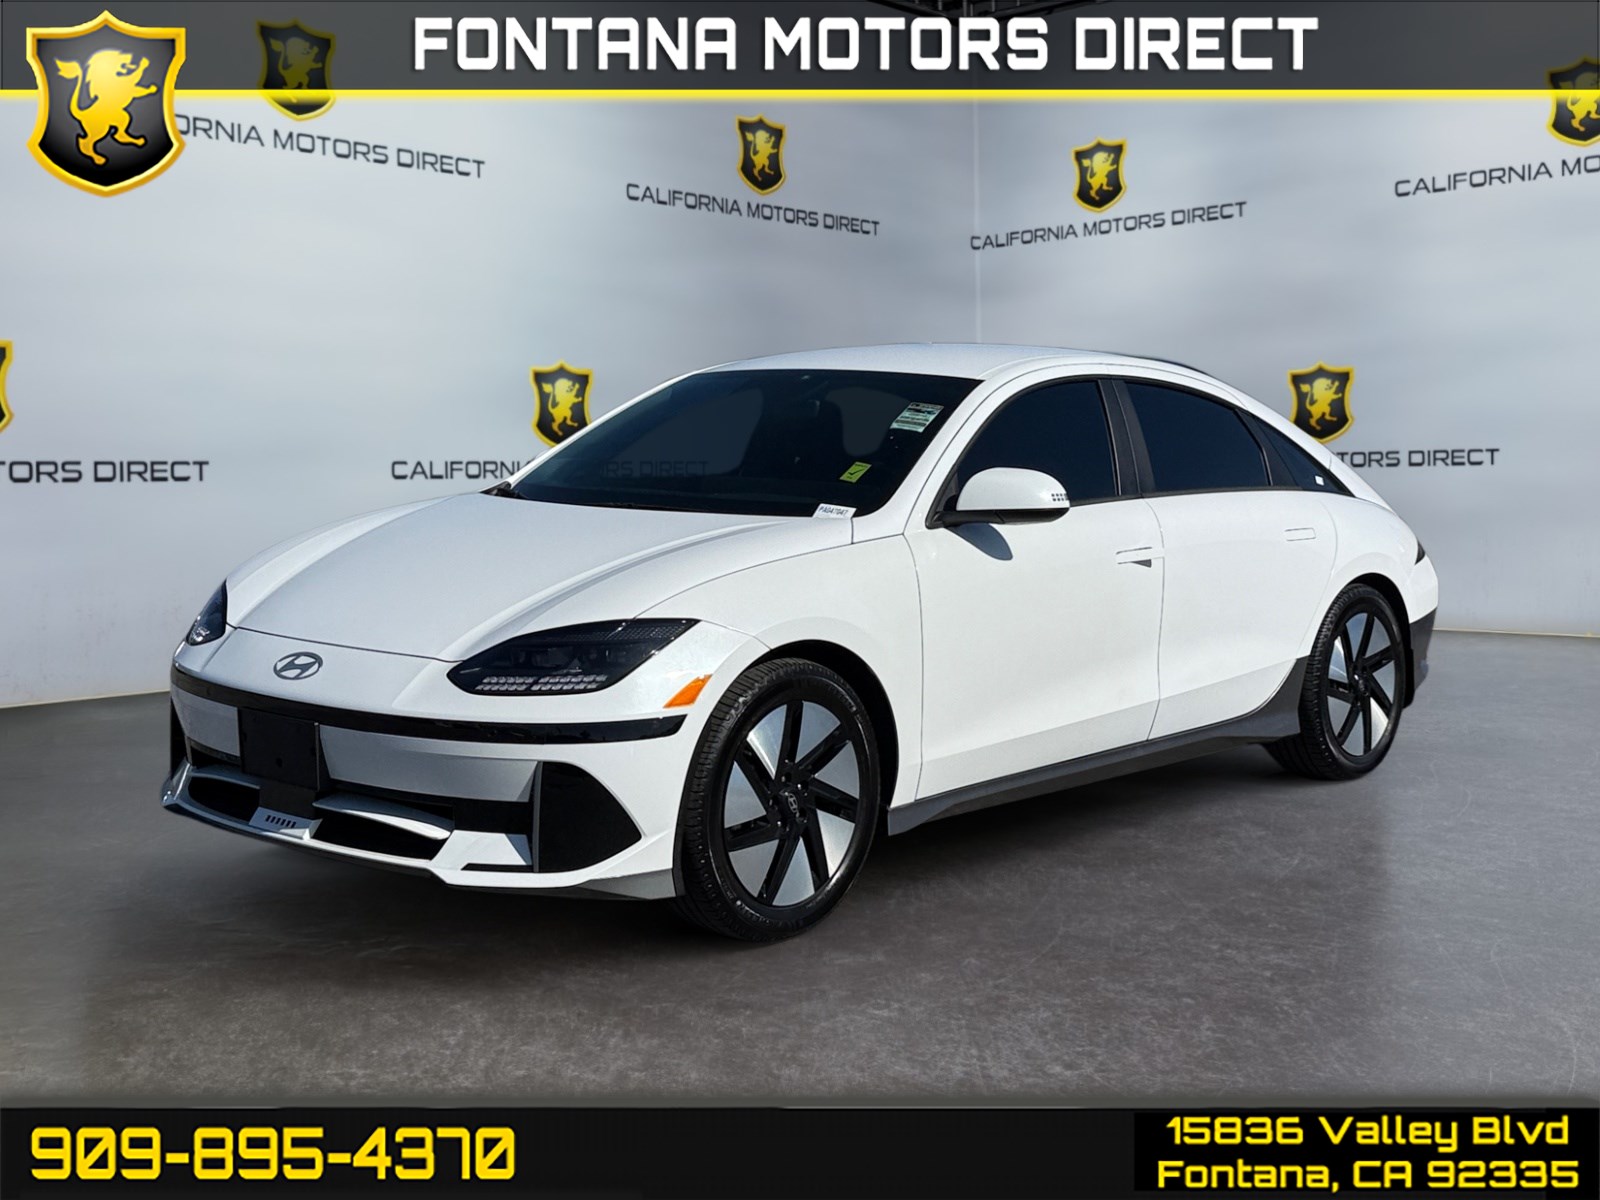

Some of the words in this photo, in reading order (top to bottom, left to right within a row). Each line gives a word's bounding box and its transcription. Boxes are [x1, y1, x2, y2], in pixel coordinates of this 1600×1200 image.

[273, 128, 389, 165] MOTORS
[396, 147, 486, 179] DIRECT
[1393, 161, 1552, 198] CALIFORNIA
[626, 183, 743, 216] CALIFORNIA
[746, 201, 819, 227] MOTORS
[823, 212, 880, 236] DIRECT
[970, 224, 1078, 250] CALIFORNIA
[1083, 212, 1166, 237] MOTORS
[1171, 201, 1248, 226] DIRECT
[93, 460, 209, 482] DIRECT
[391, 461, 533, 480] CALIFORNI
[1408, 449, 1500, 467] DIRECT
